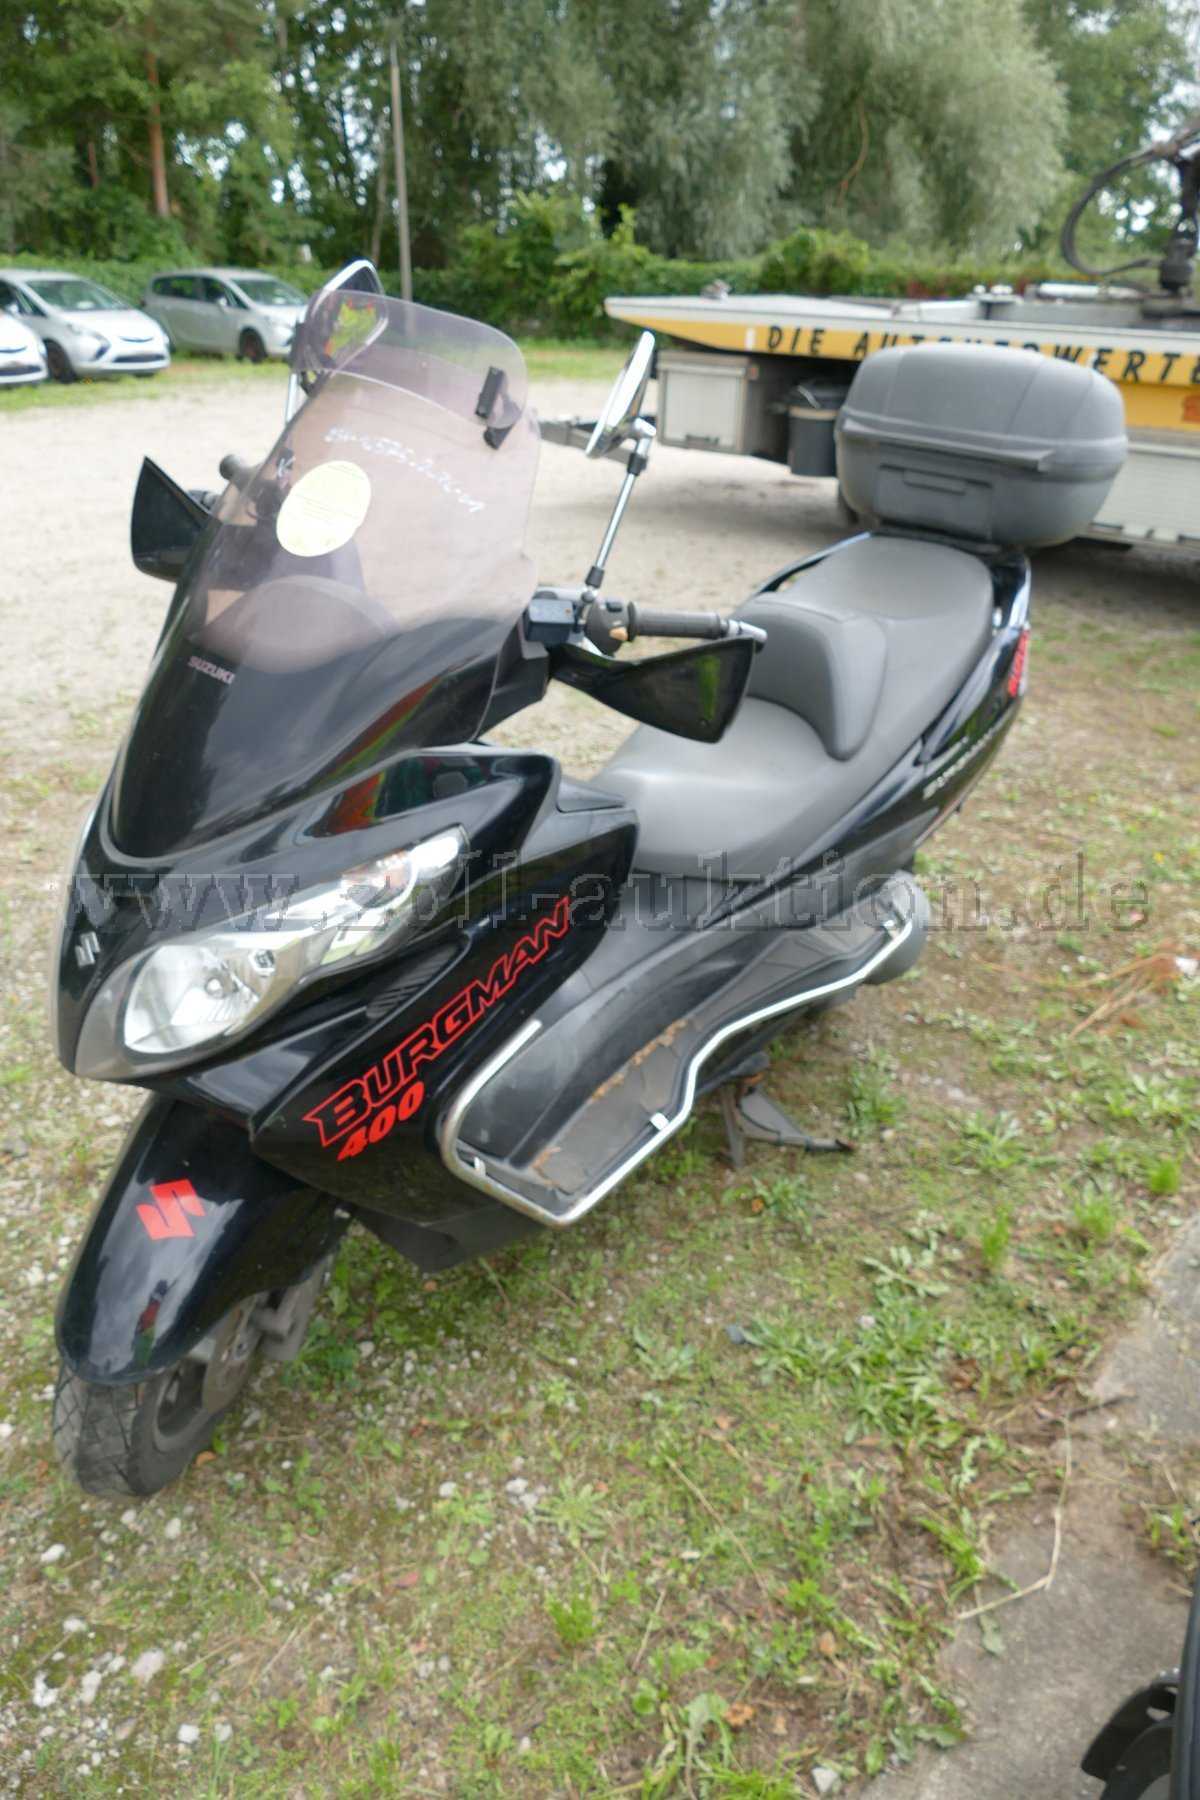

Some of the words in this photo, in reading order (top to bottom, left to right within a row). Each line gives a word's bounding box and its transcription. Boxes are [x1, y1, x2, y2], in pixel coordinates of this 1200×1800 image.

[767, 324, 825, 354] DIE
[188, 655, 236, 685] SUZUKI
[302, 895, 571, 1147] BURGMAN
[336, 1081, 425, 1161] 400
